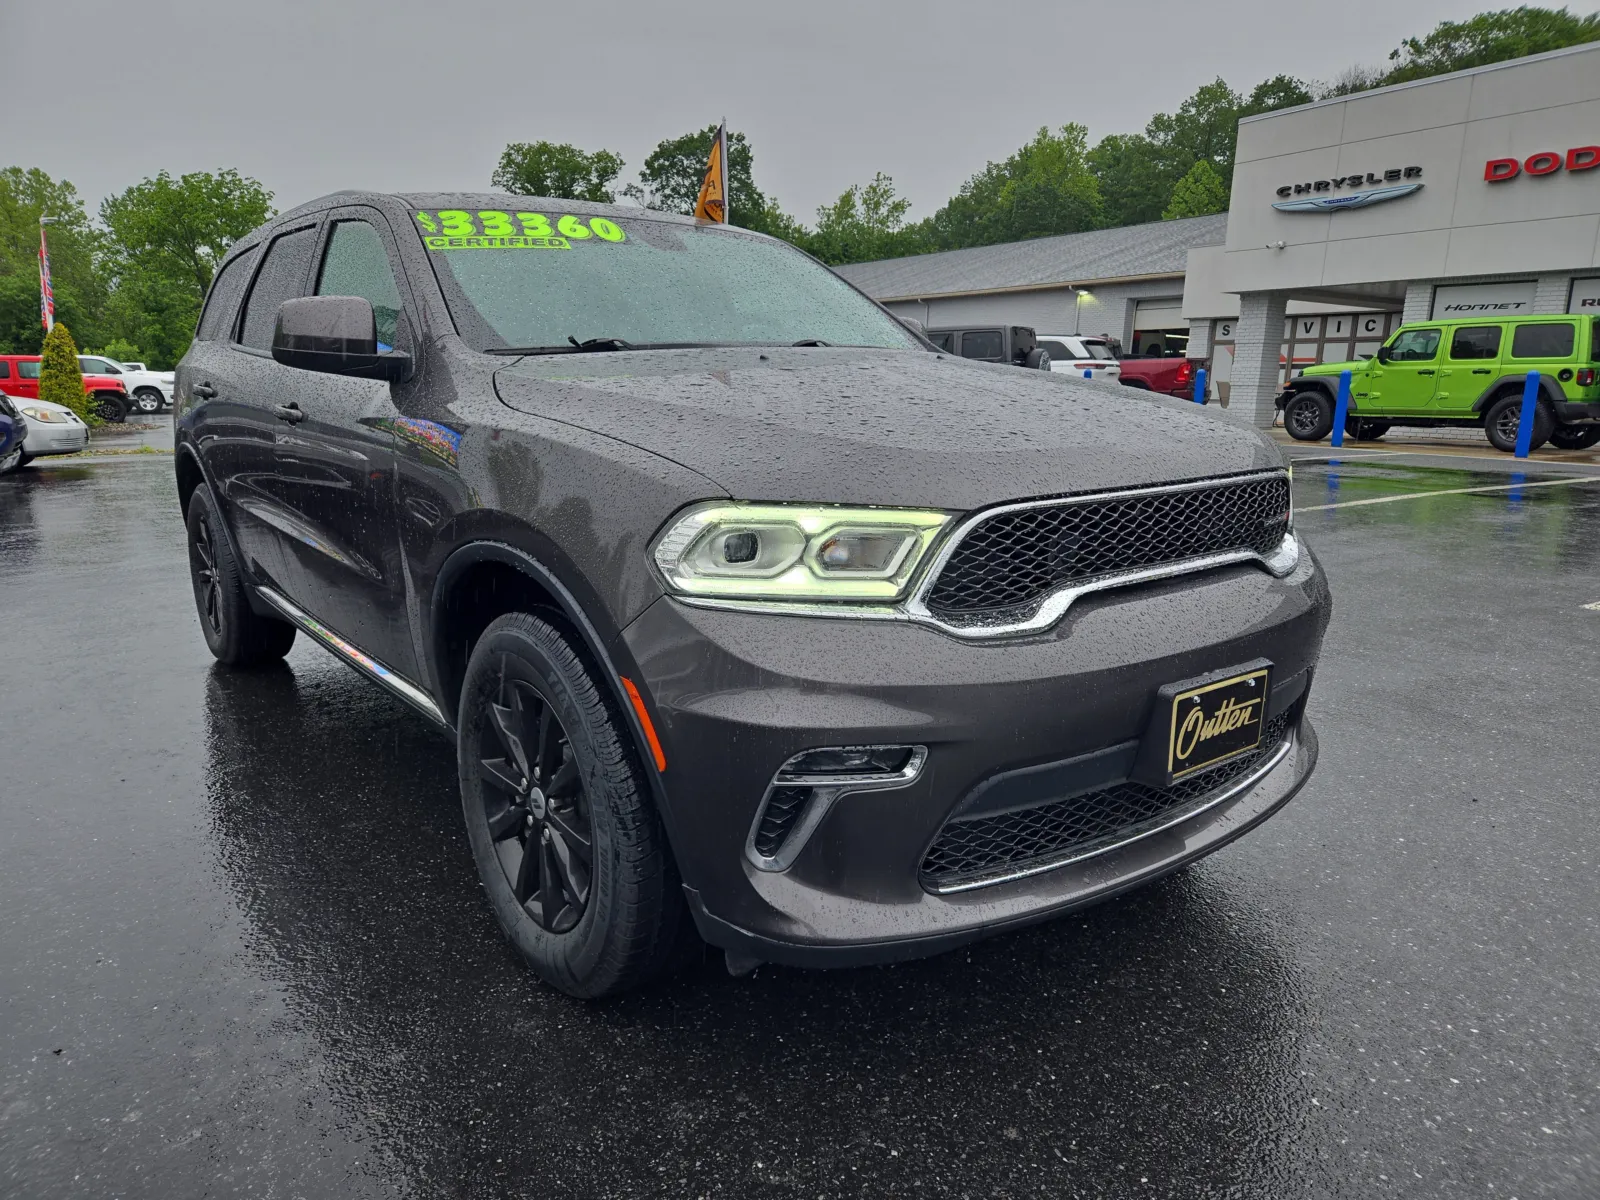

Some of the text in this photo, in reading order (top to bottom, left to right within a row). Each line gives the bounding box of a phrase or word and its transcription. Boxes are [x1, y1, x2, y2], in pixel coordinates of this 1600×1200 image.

[1276, 166, 1423, 197] CHRYSLER
[417, 210, 626, 242] $33360
[429, 237, 564, 247] CERTIFIED
[1444, 302, 1526, 311] HORNET
[1176, 697, 1261, 760] Outten
